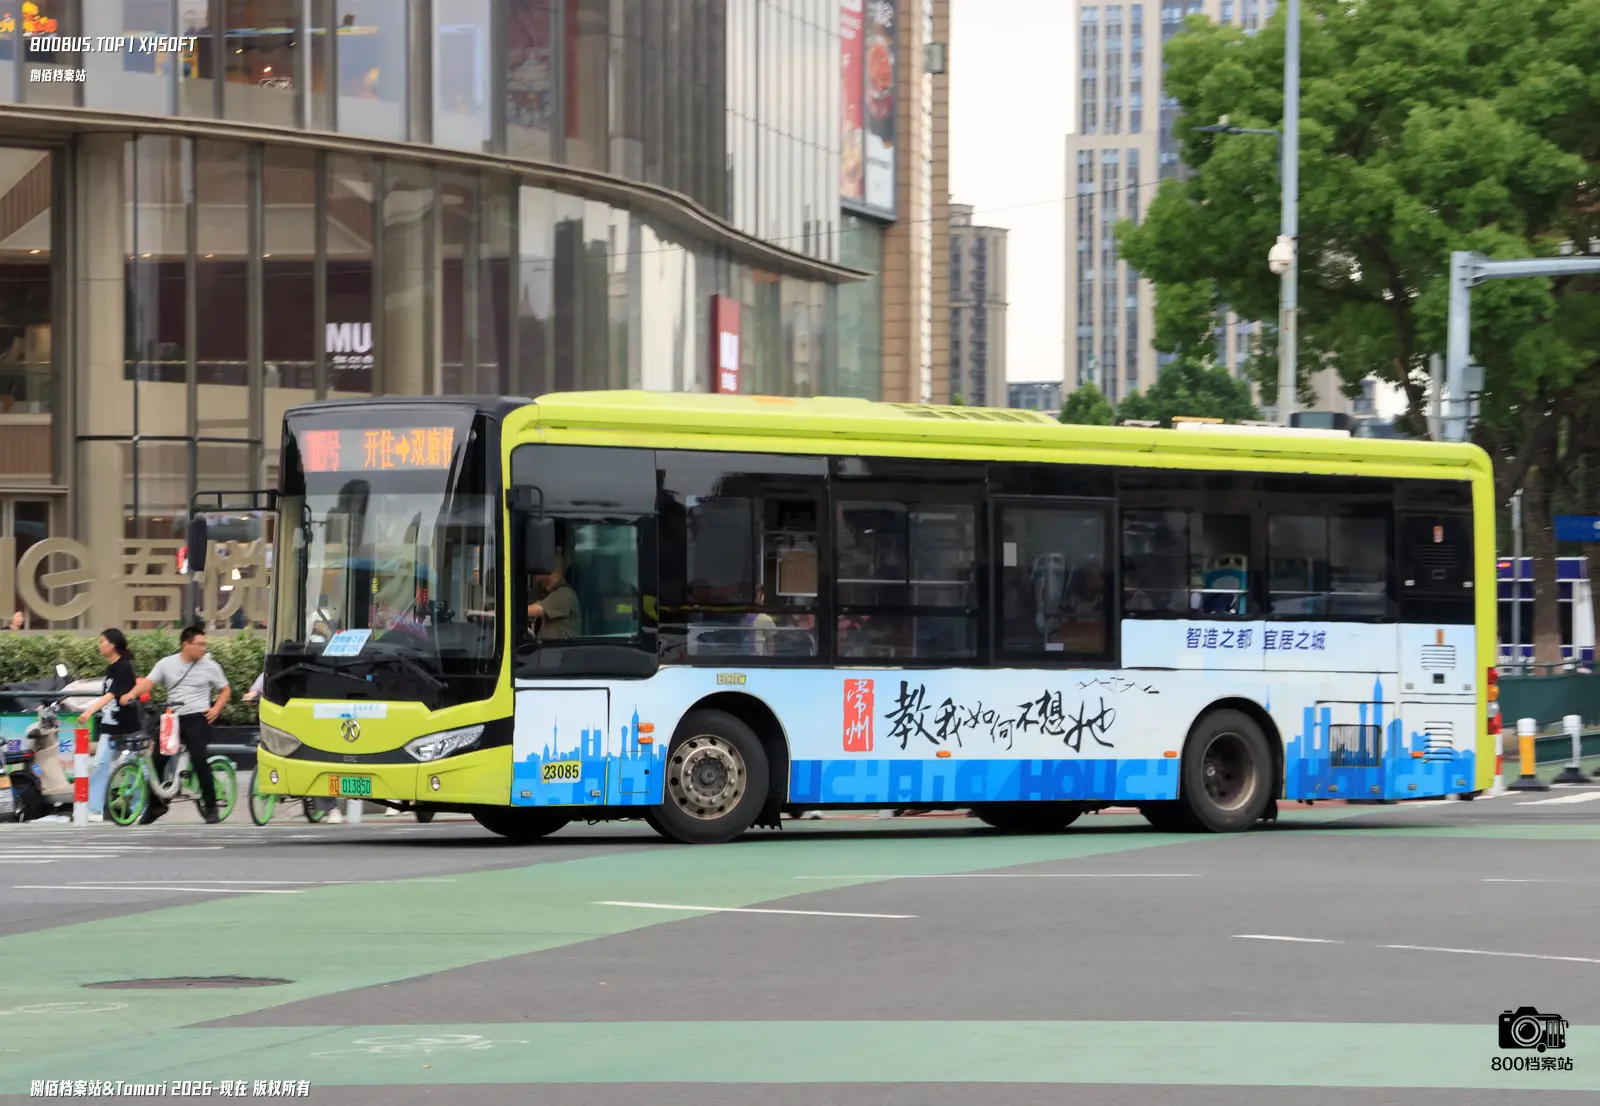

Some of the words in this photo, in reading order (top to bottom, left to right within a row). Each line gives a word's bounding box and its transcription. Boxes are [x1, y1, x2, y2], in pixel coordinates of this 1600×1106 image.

[1186, 627, 1253, 649] 智造之都
[1263, 629, 1327, 650] 宜居之城
[884, 681, 1117, 753] 教我如何不想她
[543, 764, 579, 780] 23085
